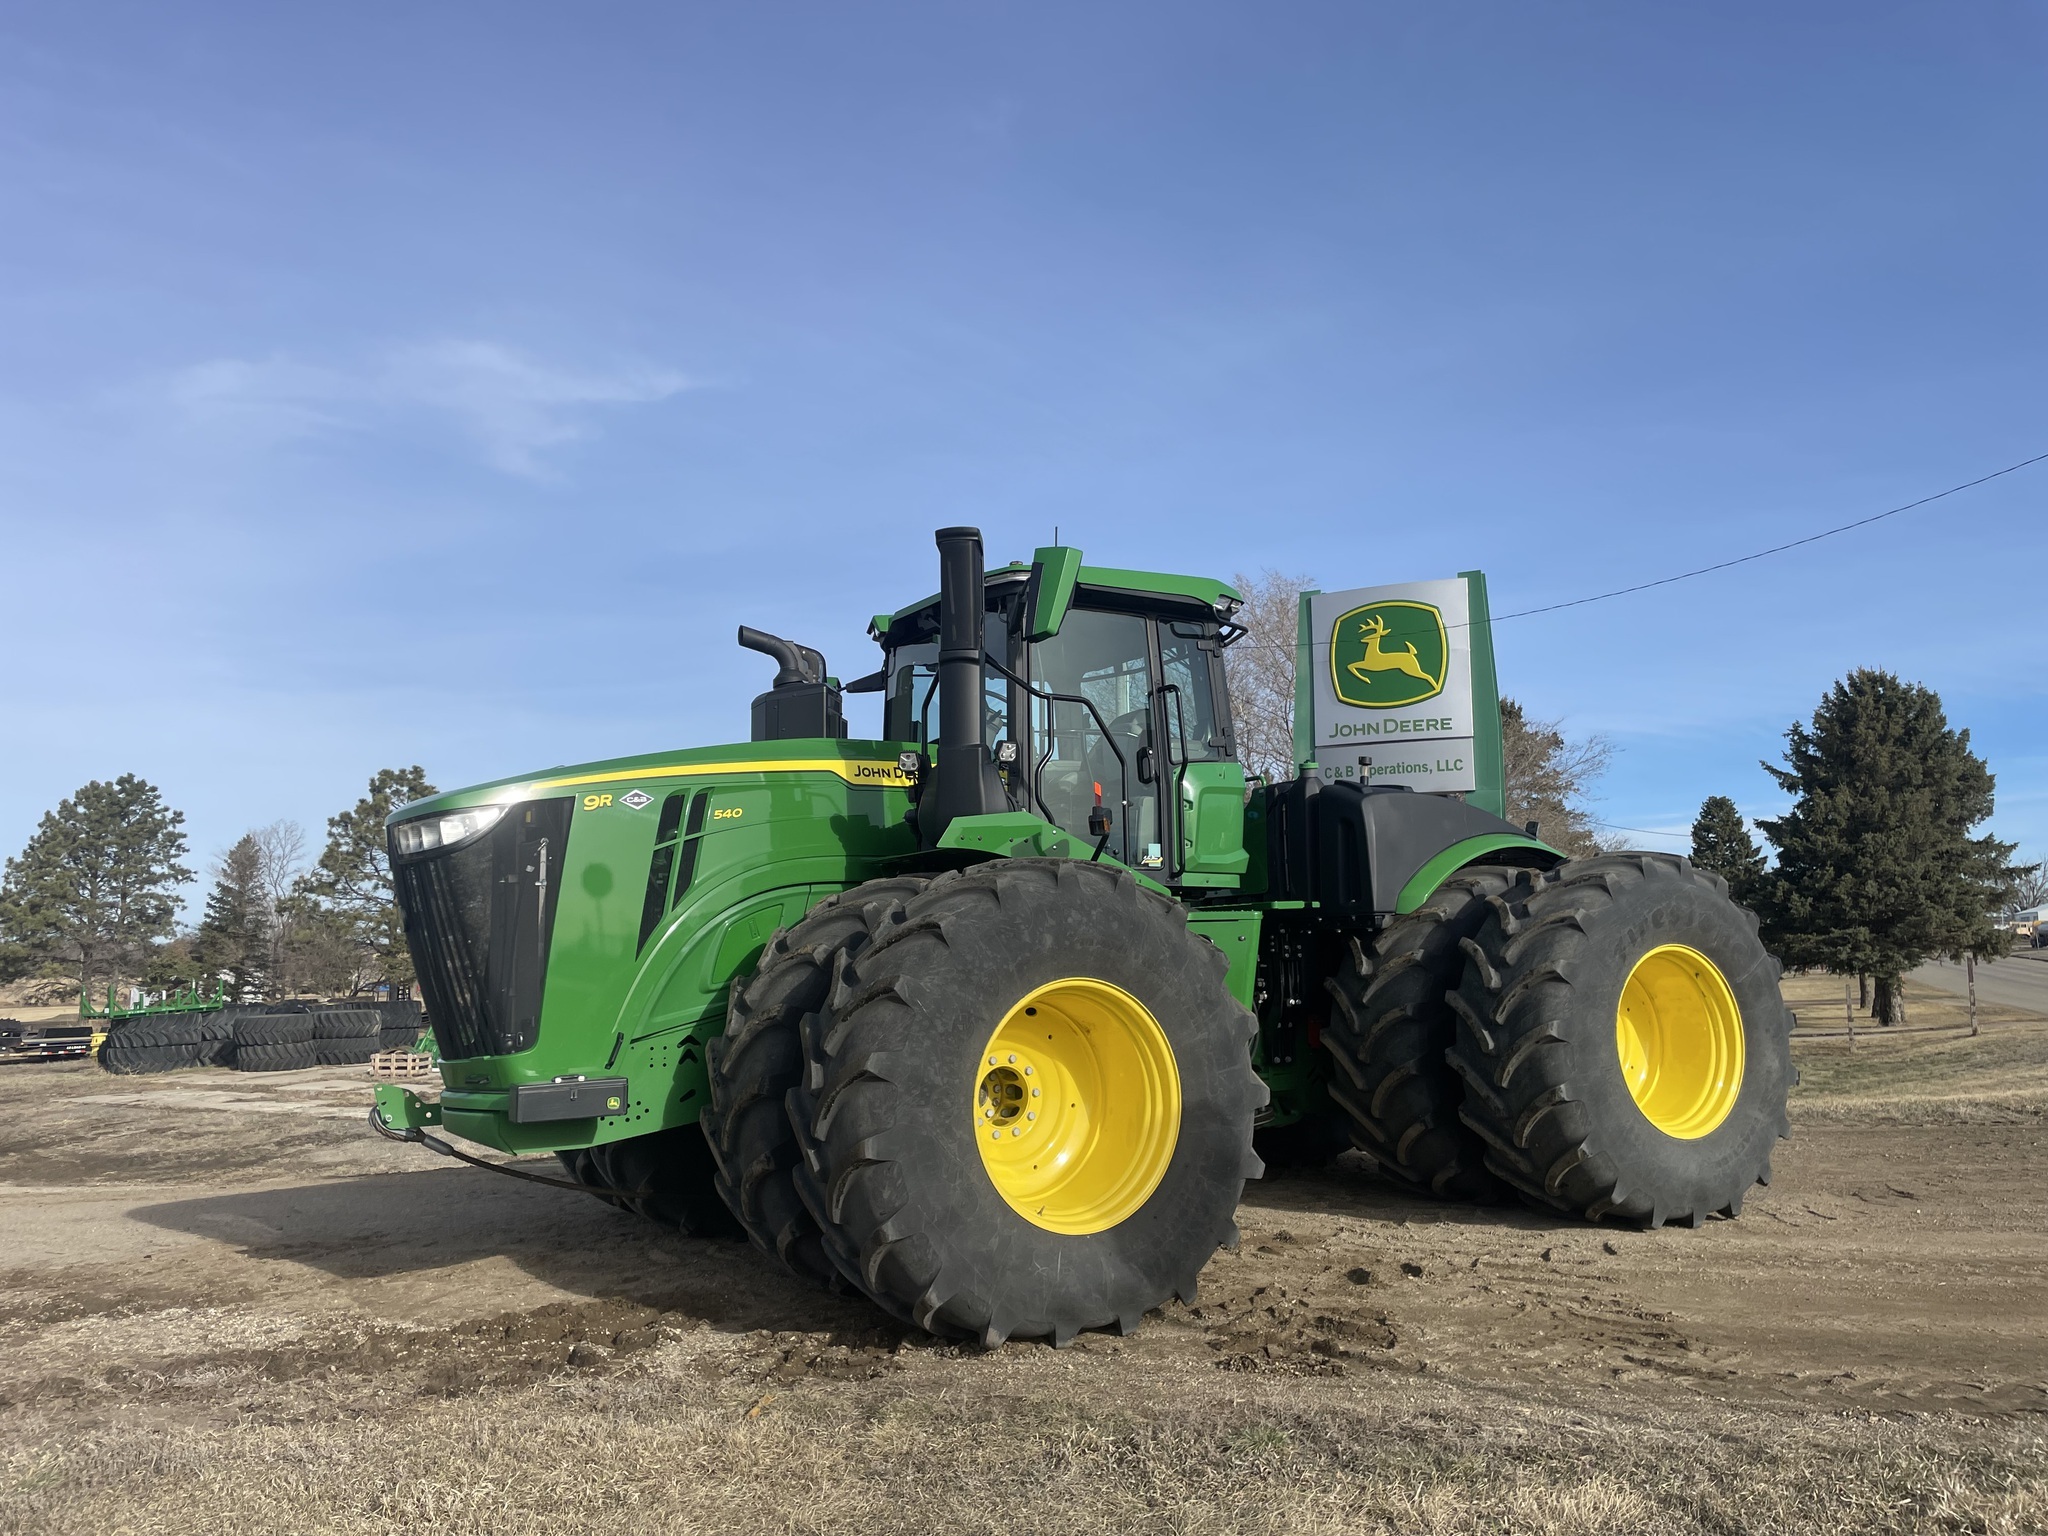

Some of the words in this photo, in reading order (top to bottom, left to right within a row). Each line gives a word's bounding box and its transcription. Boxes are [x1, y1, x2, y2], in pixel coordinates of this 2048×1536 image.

[1329, 722, 1380, 739] JOHN
[1383, 717, 1453, 734] DEERE
[854, 765, 891, 779] JOHN
[1324, 767, 1333, 779] C
[1334, 766, 1343, 778] &
[1345, 765, 1355, 778] B
[1359, 761, 1433, 779] perations,
[1436, 758, 1464, 772] LLC
[583, 794, 613, 811] 9R
[713, 807, 743, 820] 540
